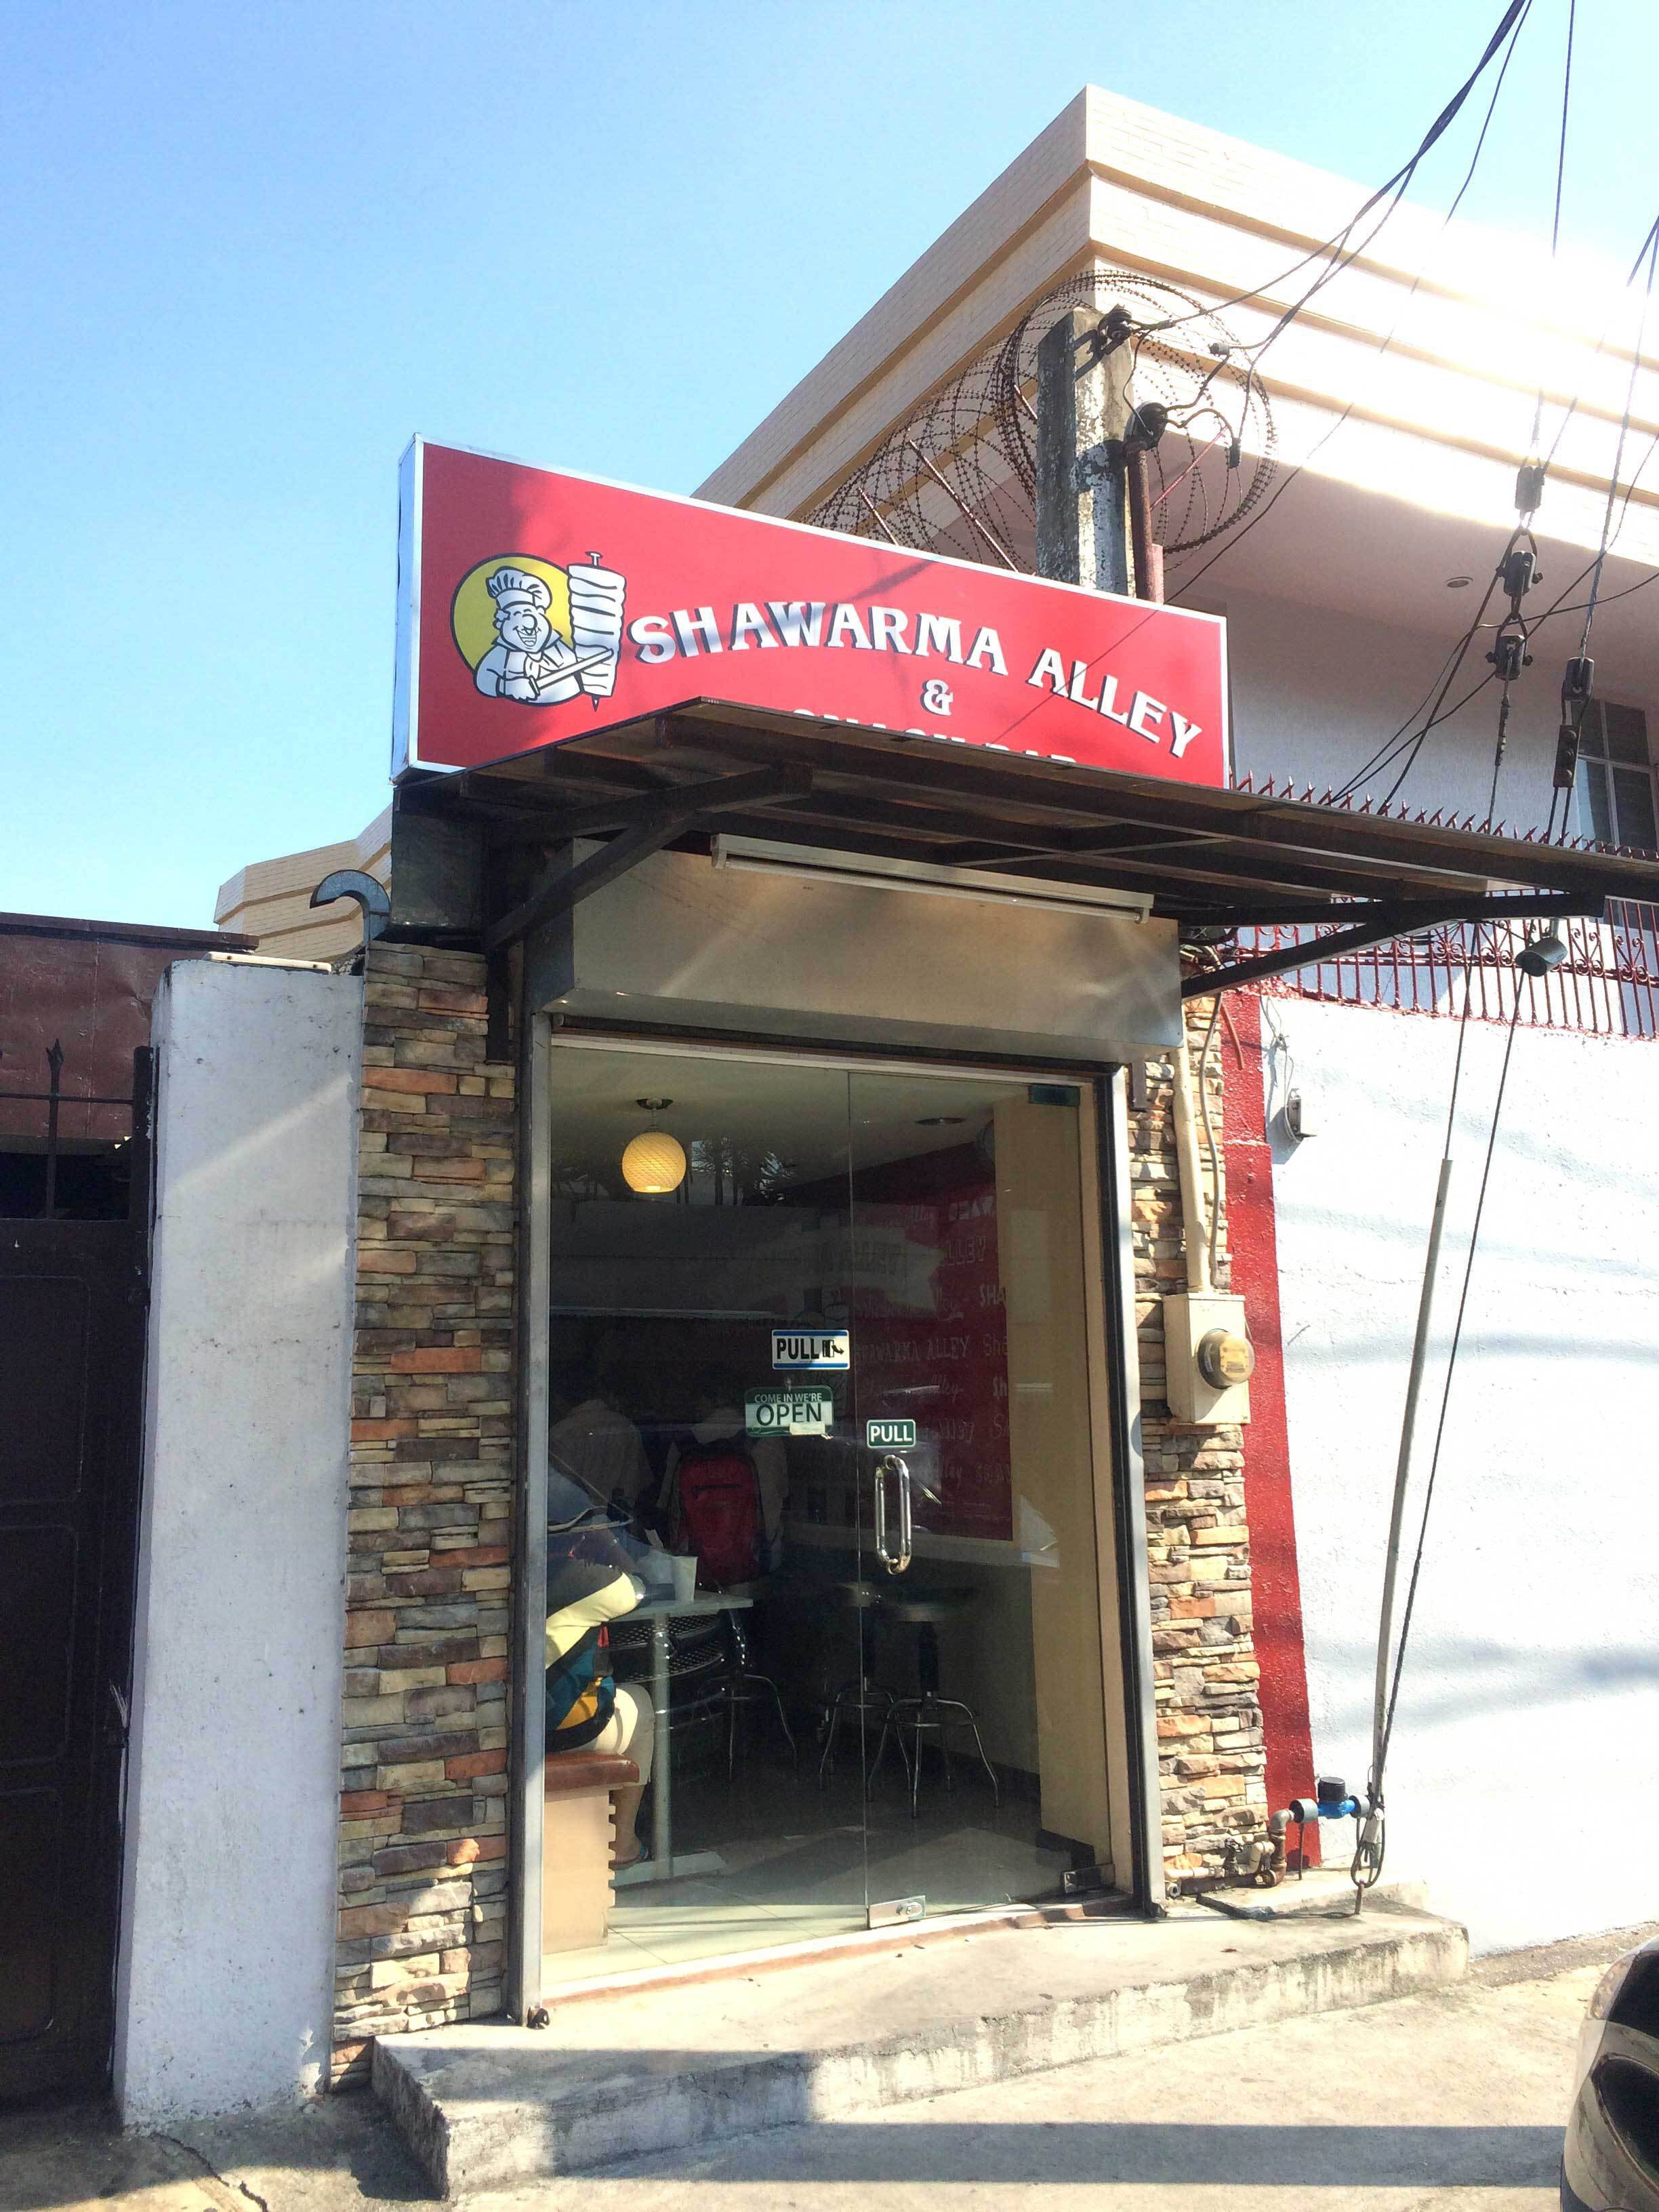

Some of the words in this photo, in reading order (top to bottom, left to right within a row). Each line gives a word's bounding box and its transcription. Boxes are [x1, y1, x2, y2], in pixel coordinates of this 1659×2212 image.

[626, 600, 1008, 677] SHAWARMA
[1027, 647, 1203, 760] ALLEY
[921, 678, 954, 716] &
[776, 1338, 820, 1359] PULL
[754, 1393, 781, 1403] COME
[783, 1393, 794, 1403] IN
[794, 1393, 823, 1402] WE'RE
[756, 1403, 822, 1426] OPEN
[869, 1425, 913, 1442] PULL
